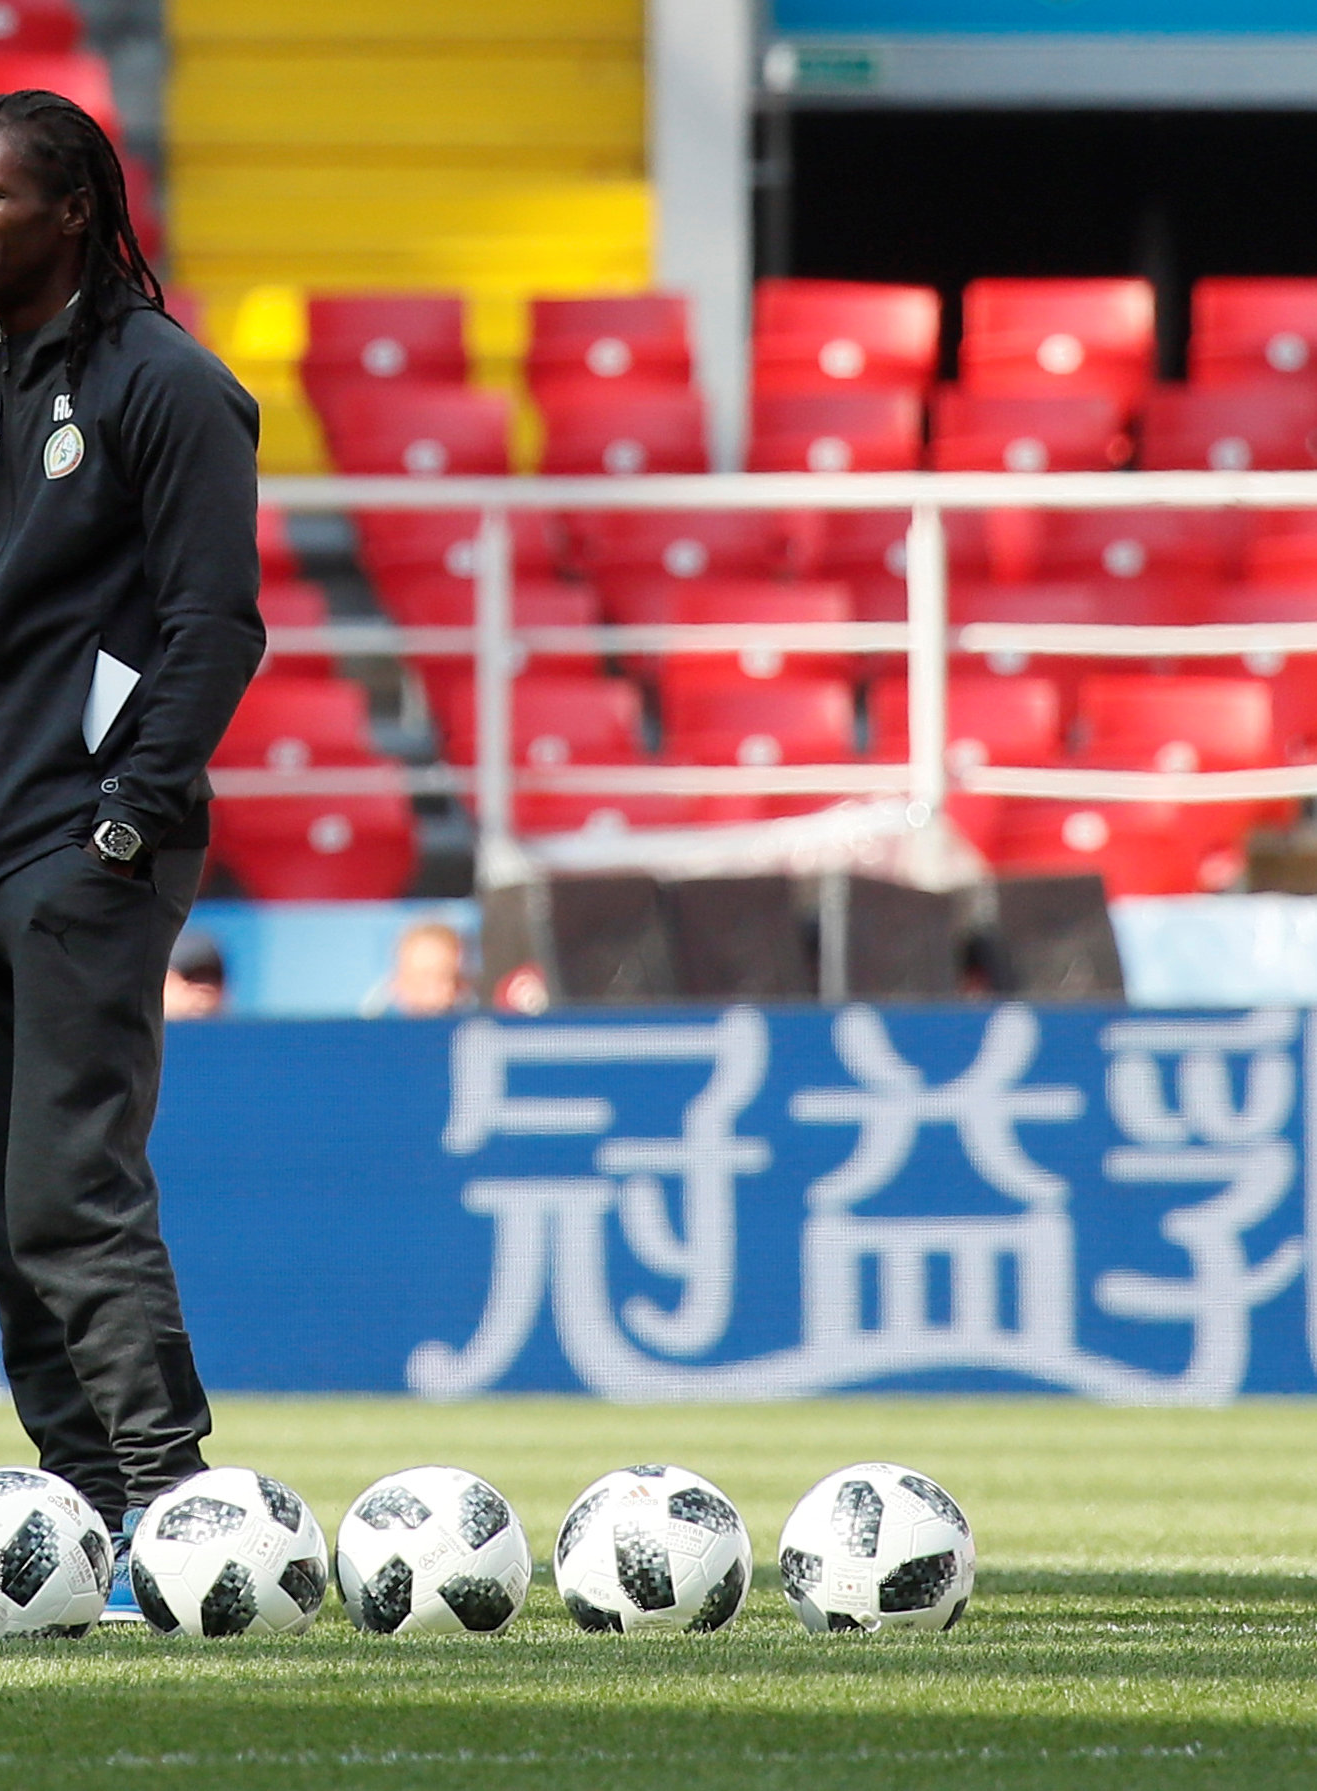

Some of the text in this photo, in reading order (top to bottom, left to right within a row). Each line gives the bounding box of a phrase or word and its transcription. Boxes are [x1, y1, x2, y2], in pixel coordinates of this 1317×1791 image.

[407, 1003, 1317, 1408] 冠益乳
[47, 1495, 82, 1527] adidas
[668, 1521, 703, 1538] TELSTAR
[73, 1545, 93, 1582] TELSTAR
